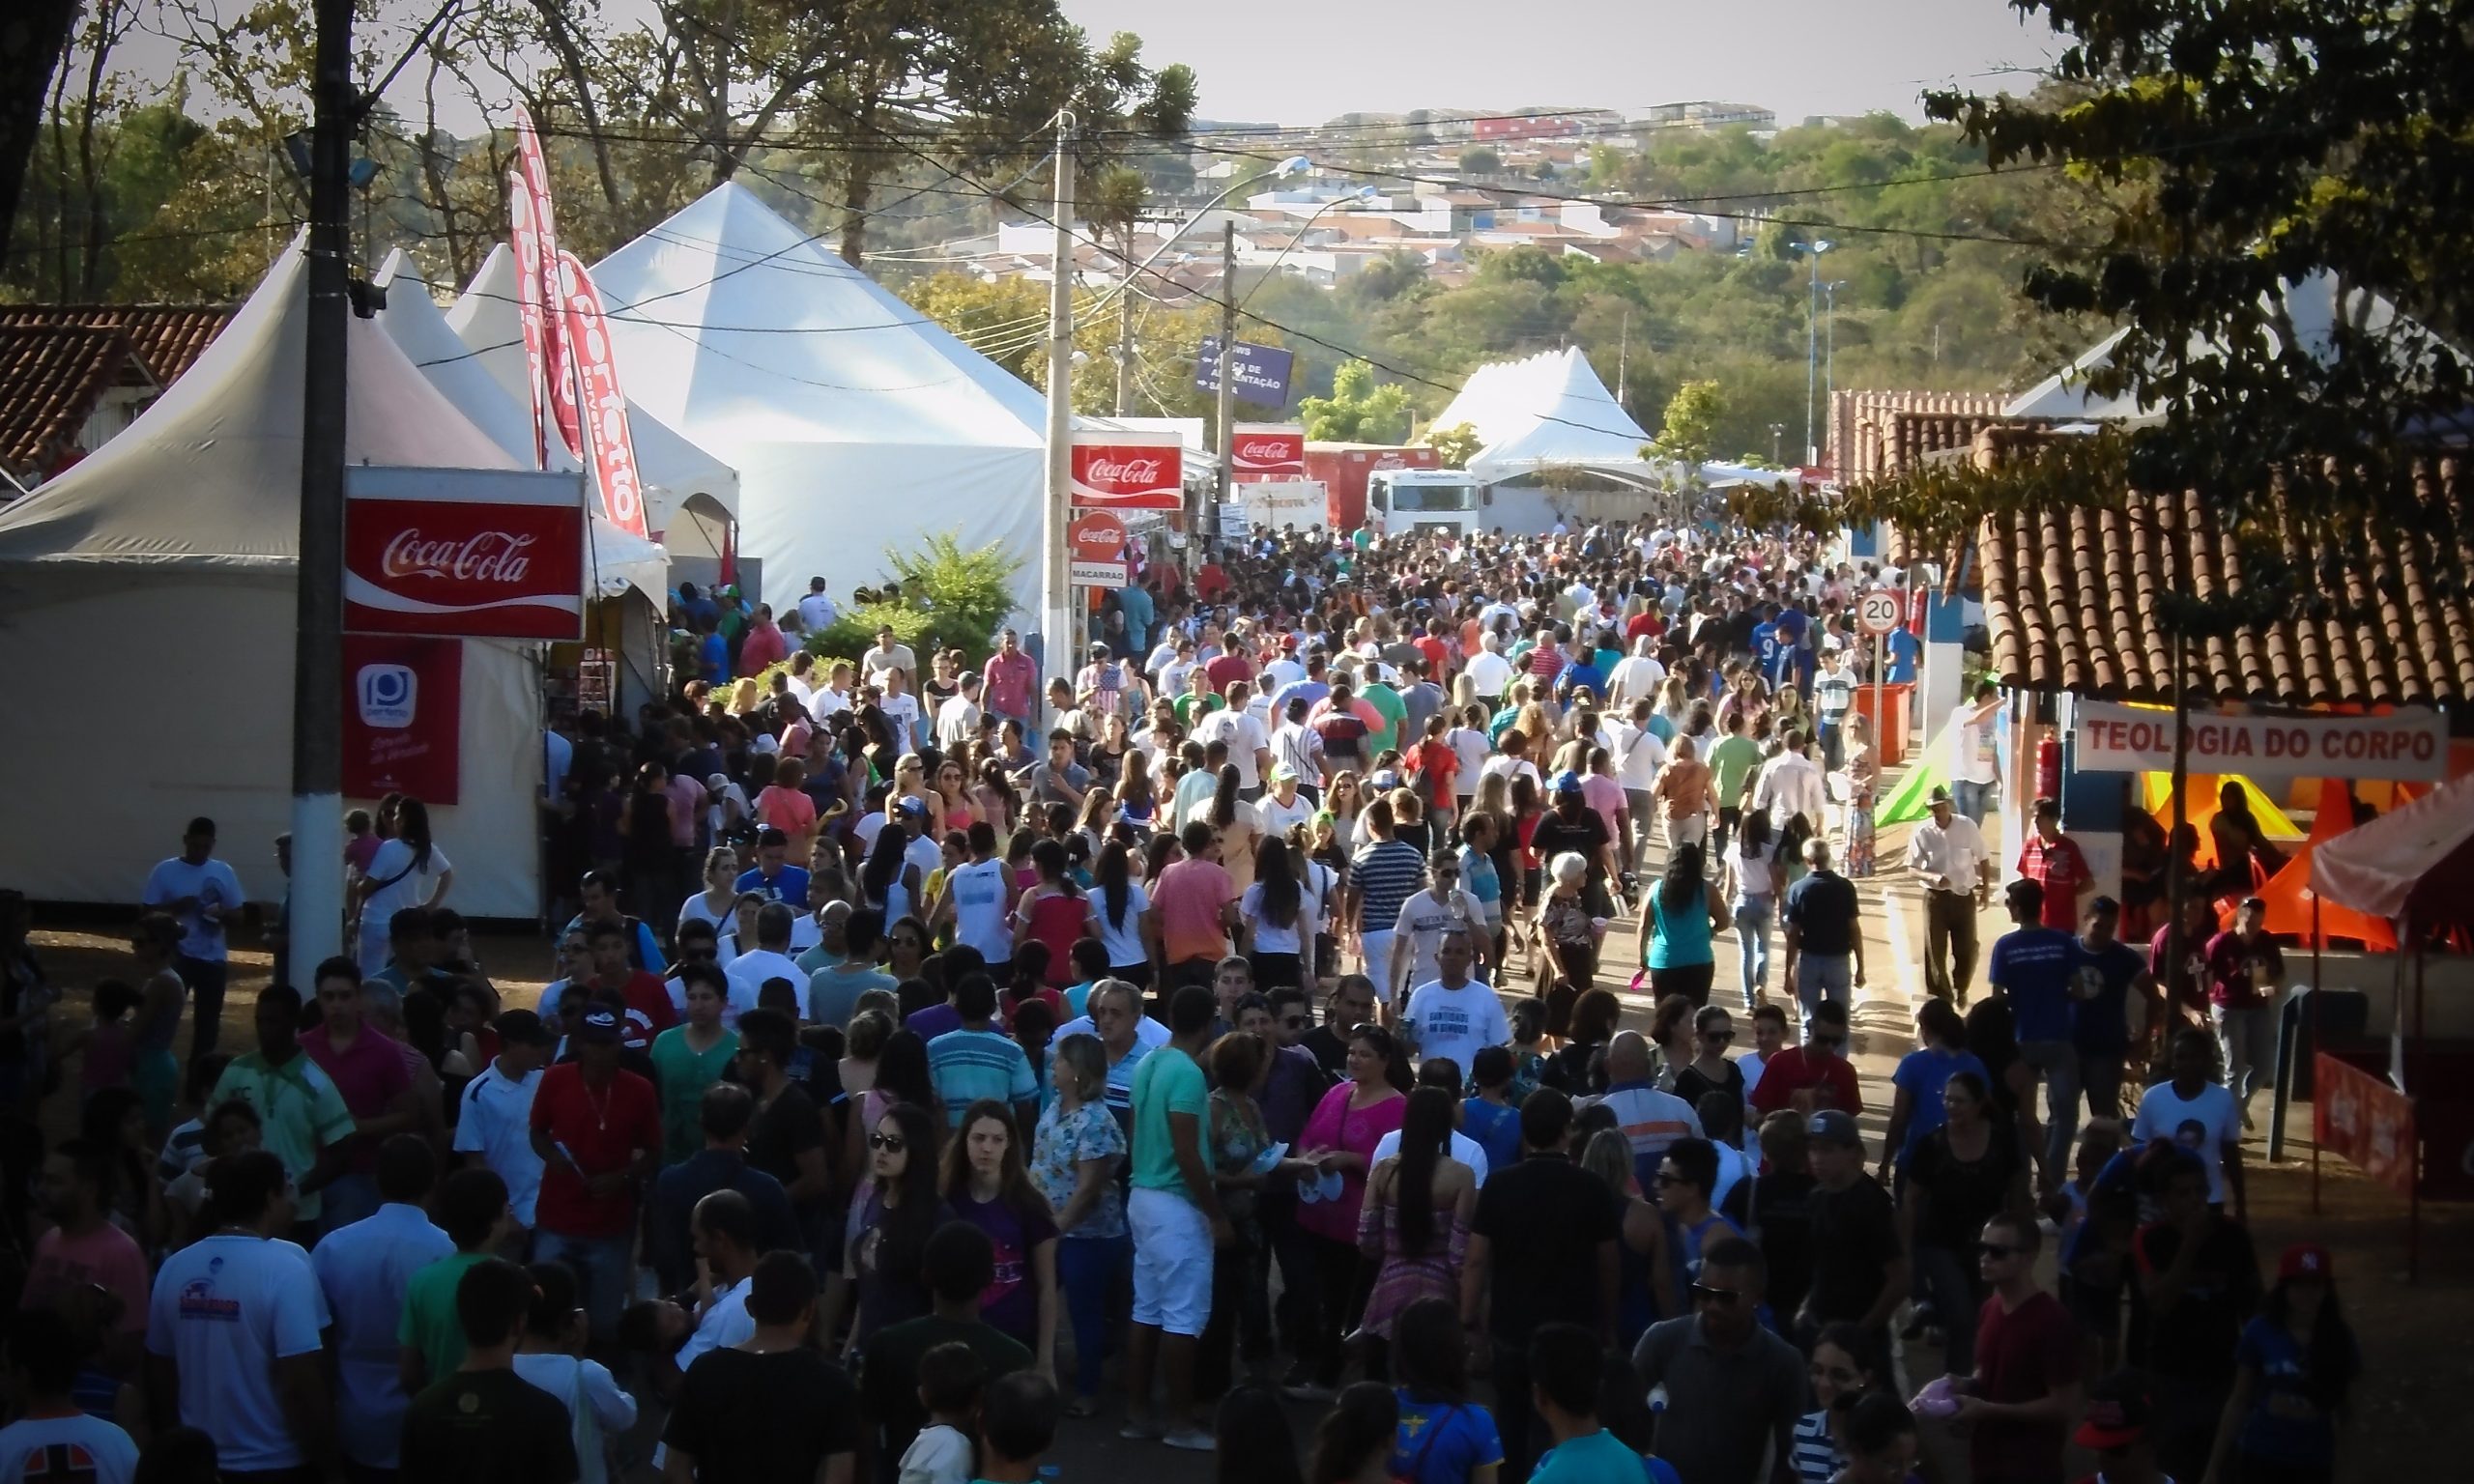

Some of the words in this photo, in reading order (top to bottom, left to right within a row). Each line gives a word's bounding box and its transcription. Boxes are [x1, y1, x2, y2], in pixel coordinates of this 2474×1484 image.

[1248, 364, 1261, 375] DE
[573, 292, 636, 522] perfetto
[1243, 442, 1290, 459] Coca-Cola
[1087, 458, 1162, 484] Coca-Cola
[1078, 528, 1120, 545] Coca-Cola
[383, 528, 537, 583] Coca-Cola
[1866, 600, 1894, 619] 20
[1763, 639, 1774, 660] 9
[2265, 728, 2311, 757] DO
[2321, 729, 2434, 761] CORPO
